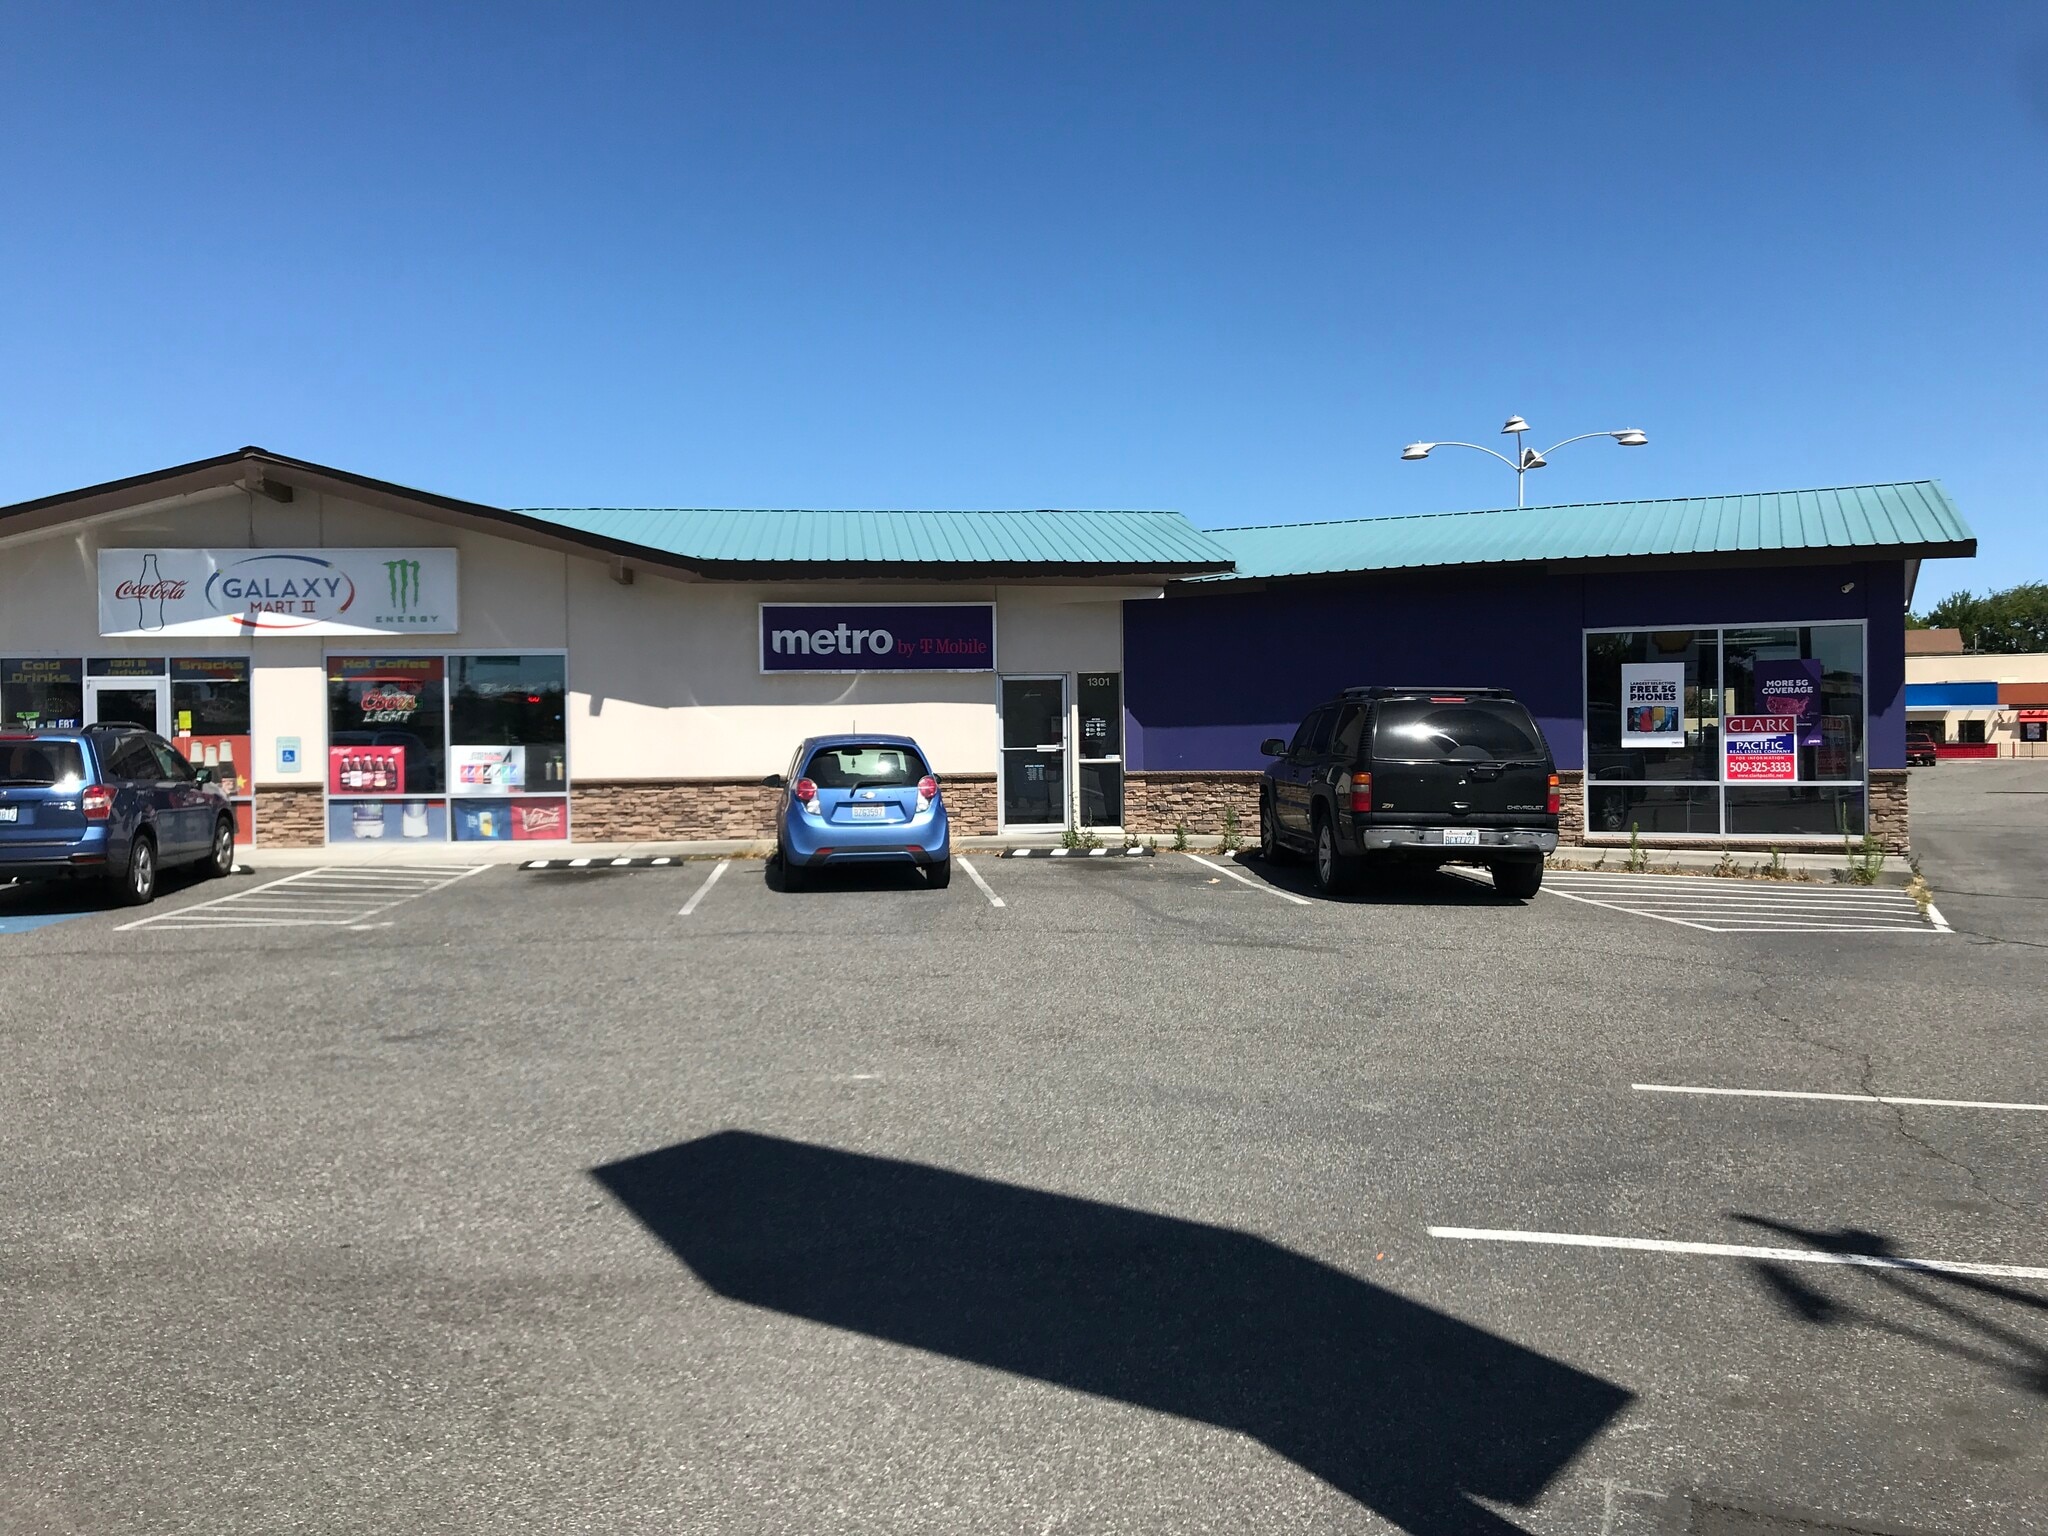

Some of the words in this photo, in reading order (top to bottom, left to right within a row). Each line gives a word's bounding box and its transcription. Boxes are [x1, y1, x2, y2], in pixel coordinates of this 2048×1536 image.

[222, 577, 341, 599] GALAXY
[250, 601, 295, 613] MART
[302, 601, 316, 613] II
[375, 615, 439, 623] ENERGY
[771, 623, 894, 655] metro
[897, 638, 916, 658] by
[935, 638, 987, 654] Mobile
[22, 661, 60, 670] Cold
[180, 661, 244, 670] Snacks
[343, 660, 371, 669] Hot
[375, 660, 430, 669] Coffee
[12, 673, 71, 683] Drinks
[1087, 677, 1110, 687] 1301
[1630, 685, 1658, 693] FREE
[1661, 685, 1676, 693] 5G
[1630, 693, 1676, 701] PHONES
[361, 694, 417, 711] Coors
[363, 710, 415, 722] LIGHT
[58, 719, 74, 728] EBT
[1729, 719, 1790, 731] CLARK
[1736, 741, 1784, 750] PACIFIC
[1730, 762, 1792, 773] 509-325-3333
